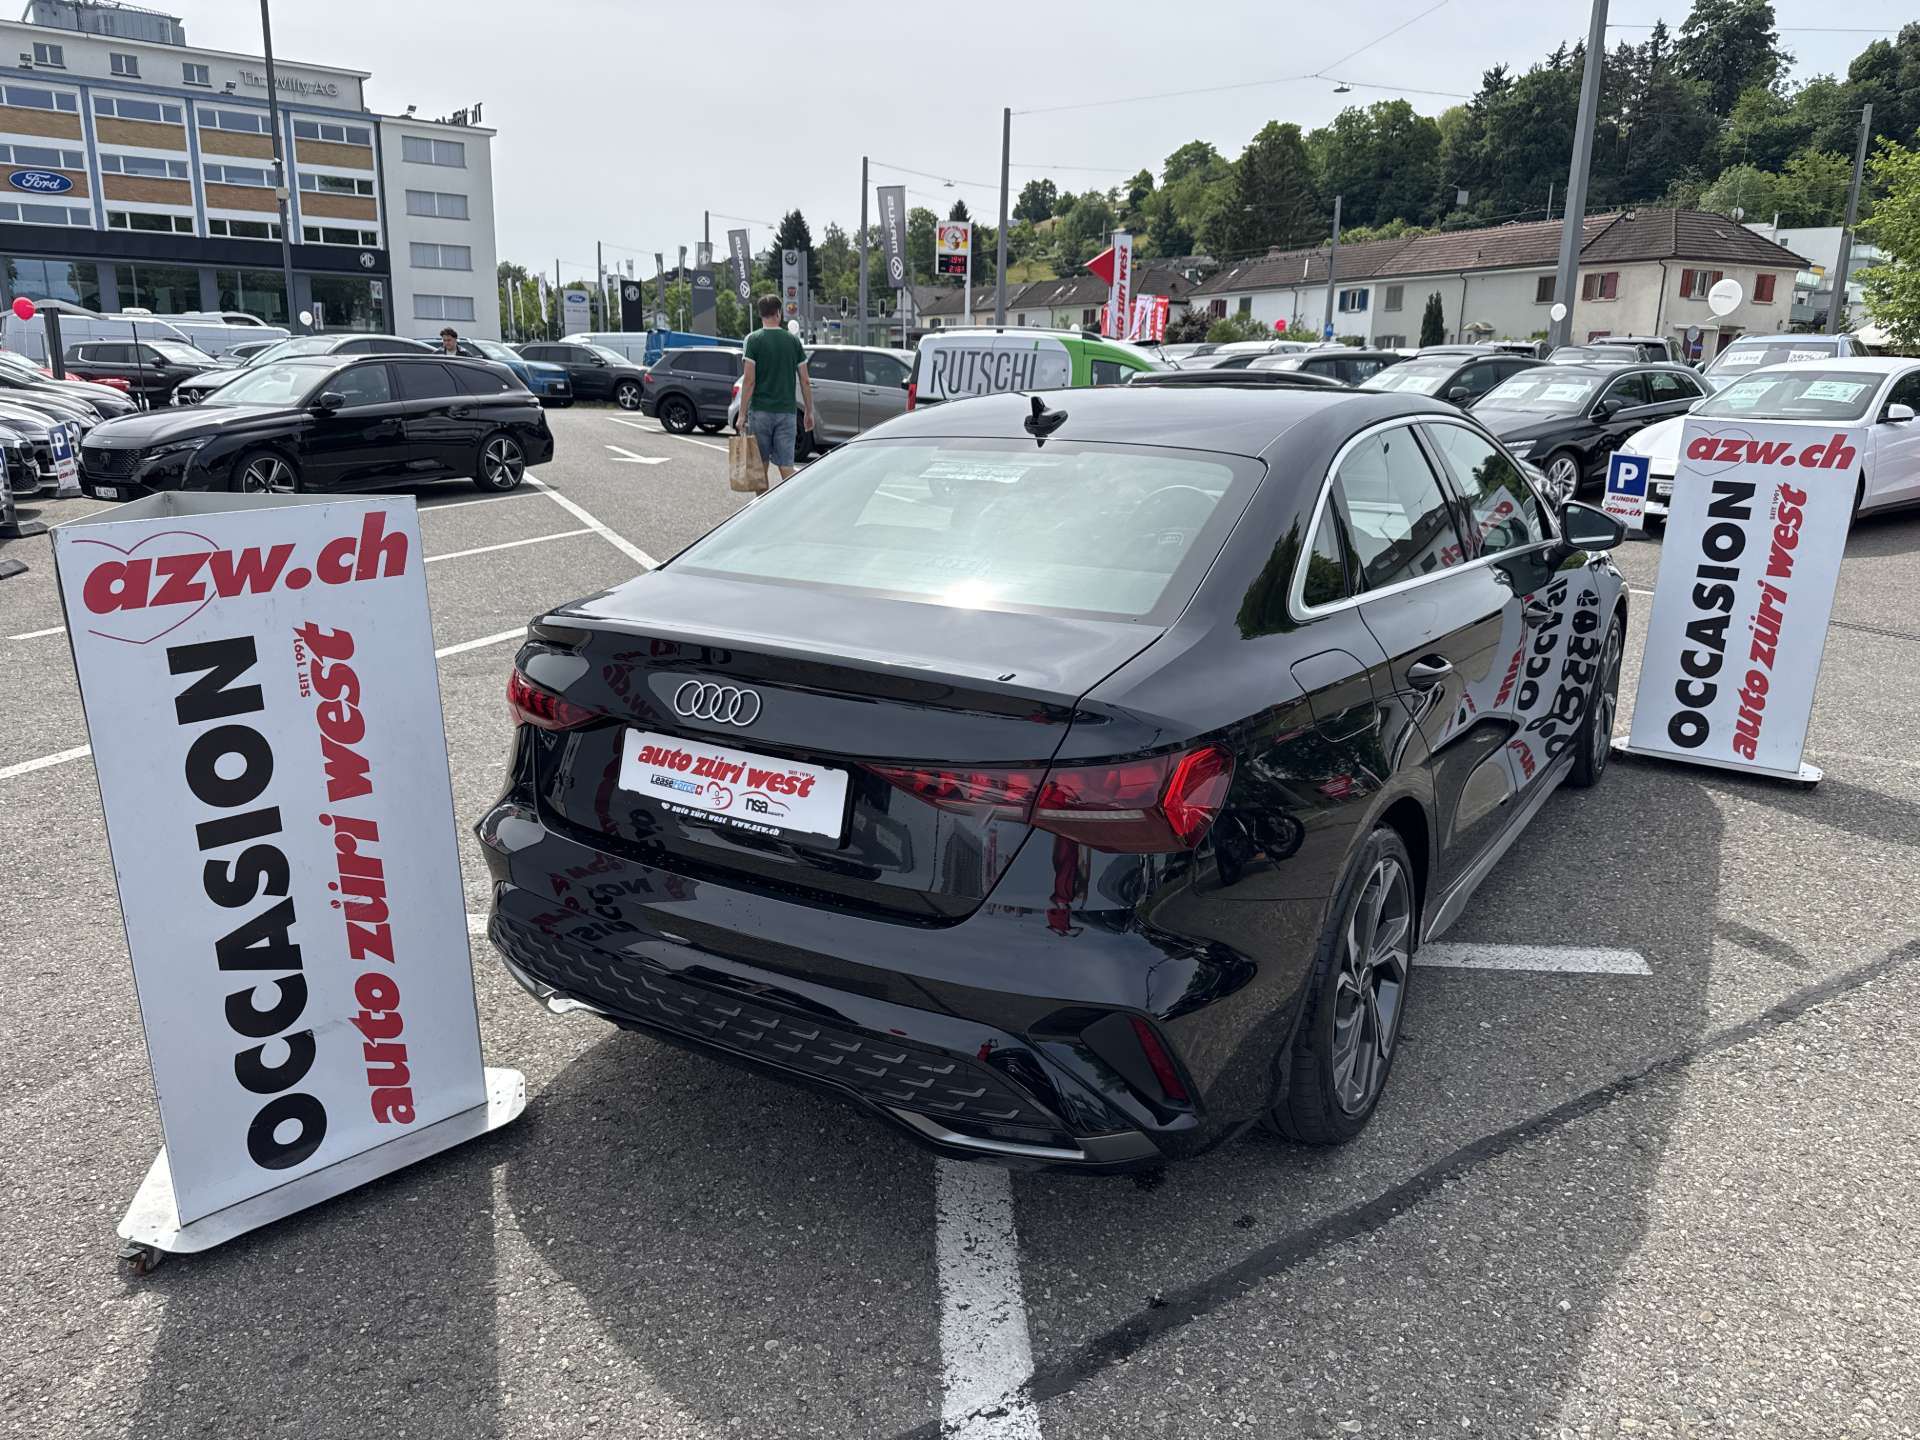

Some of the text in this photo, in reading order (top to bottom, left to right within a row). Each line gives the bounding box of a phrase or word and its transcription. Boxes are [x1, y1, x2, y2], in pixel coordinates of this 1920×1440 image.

[275, 75, 309, 95] Willy
[314, 80, 338, 96] AG
[22, 173, 60, 189] Ford
[360, 252, 375, 268] MG
[624, 285, 639, 301] MG
[931, 341, 1040, 400] RUTSCHI
[54, 431, 64, 456] P
[1686, 434, 1857, 470] azw.ch
[1617, 462, 1638, 488] P
[1605, 506, 1642, 517] azw.ch
[1611, 495, 1639, 503] KUNDEN
[83, 511, 408, 614] azw.ch
[1667, 480, 1756, 748] OCCASION
[1732, 482, 1807, 760] auto züri west
[293, 638, 311, 697] SEIT 1991
[638, 745, 816, 797] auto züri west
[671, 804, 780, 836] auto züri west www.azw.ch
[745, 798, 768, 814] nsa
[292, 621, 416, 1125] auto züri west
[166, 635, 327, 1170] OCCASION
